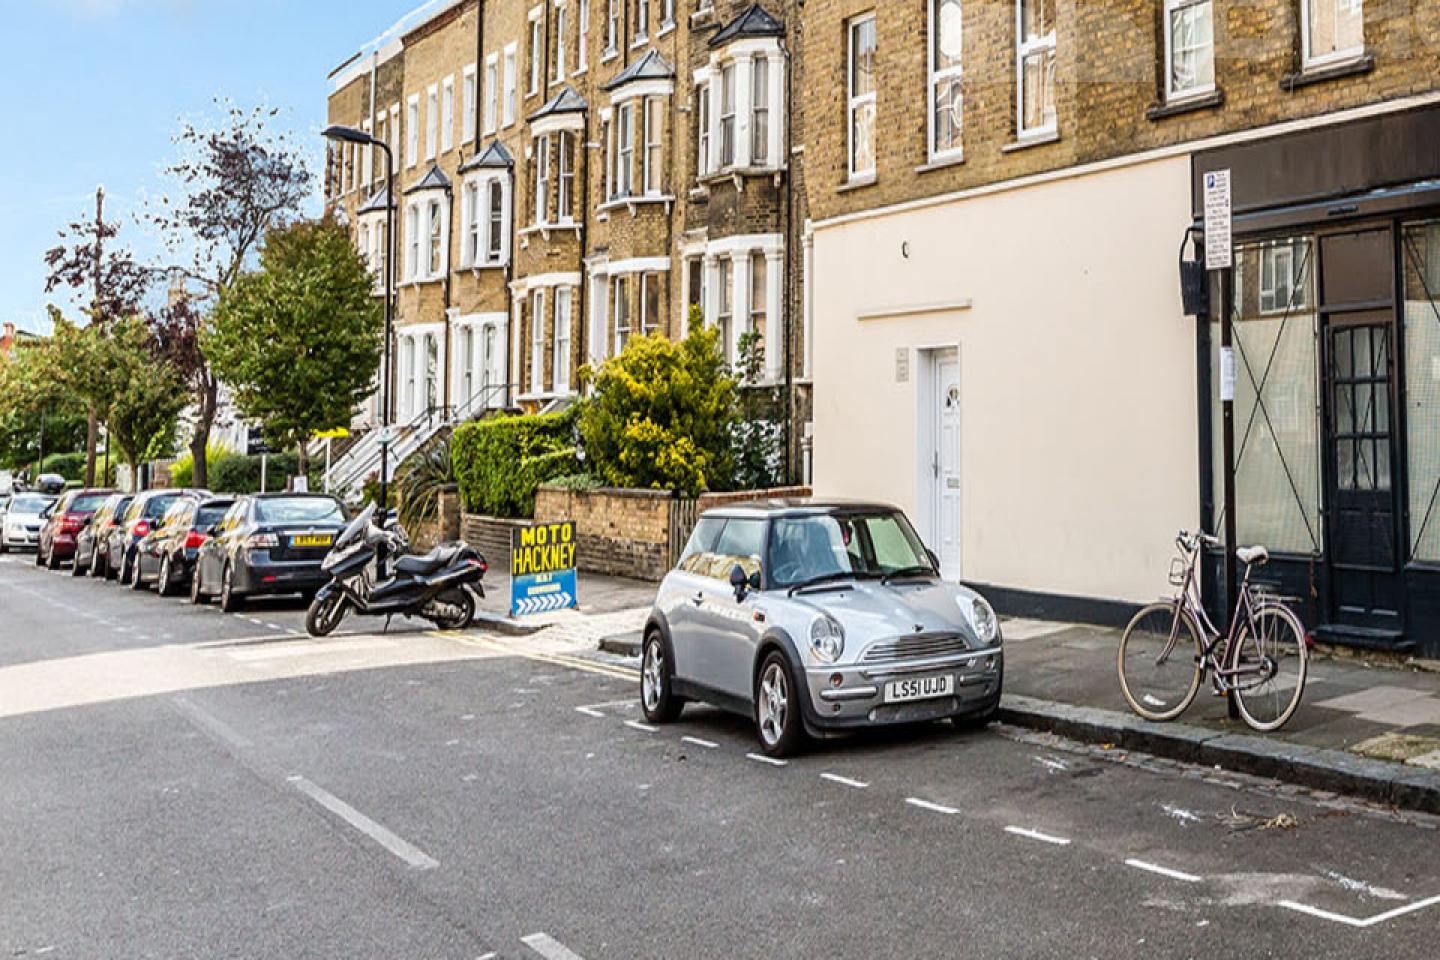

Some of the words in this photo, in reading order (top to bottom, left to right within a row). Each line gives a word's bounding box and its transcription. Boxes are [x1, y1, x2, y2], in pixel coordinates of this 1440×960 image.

[521, 522, 572, 547] MOTO
[513, 542, 576, 575] HACKNEY
[892, 680, 922, 699] LS51
